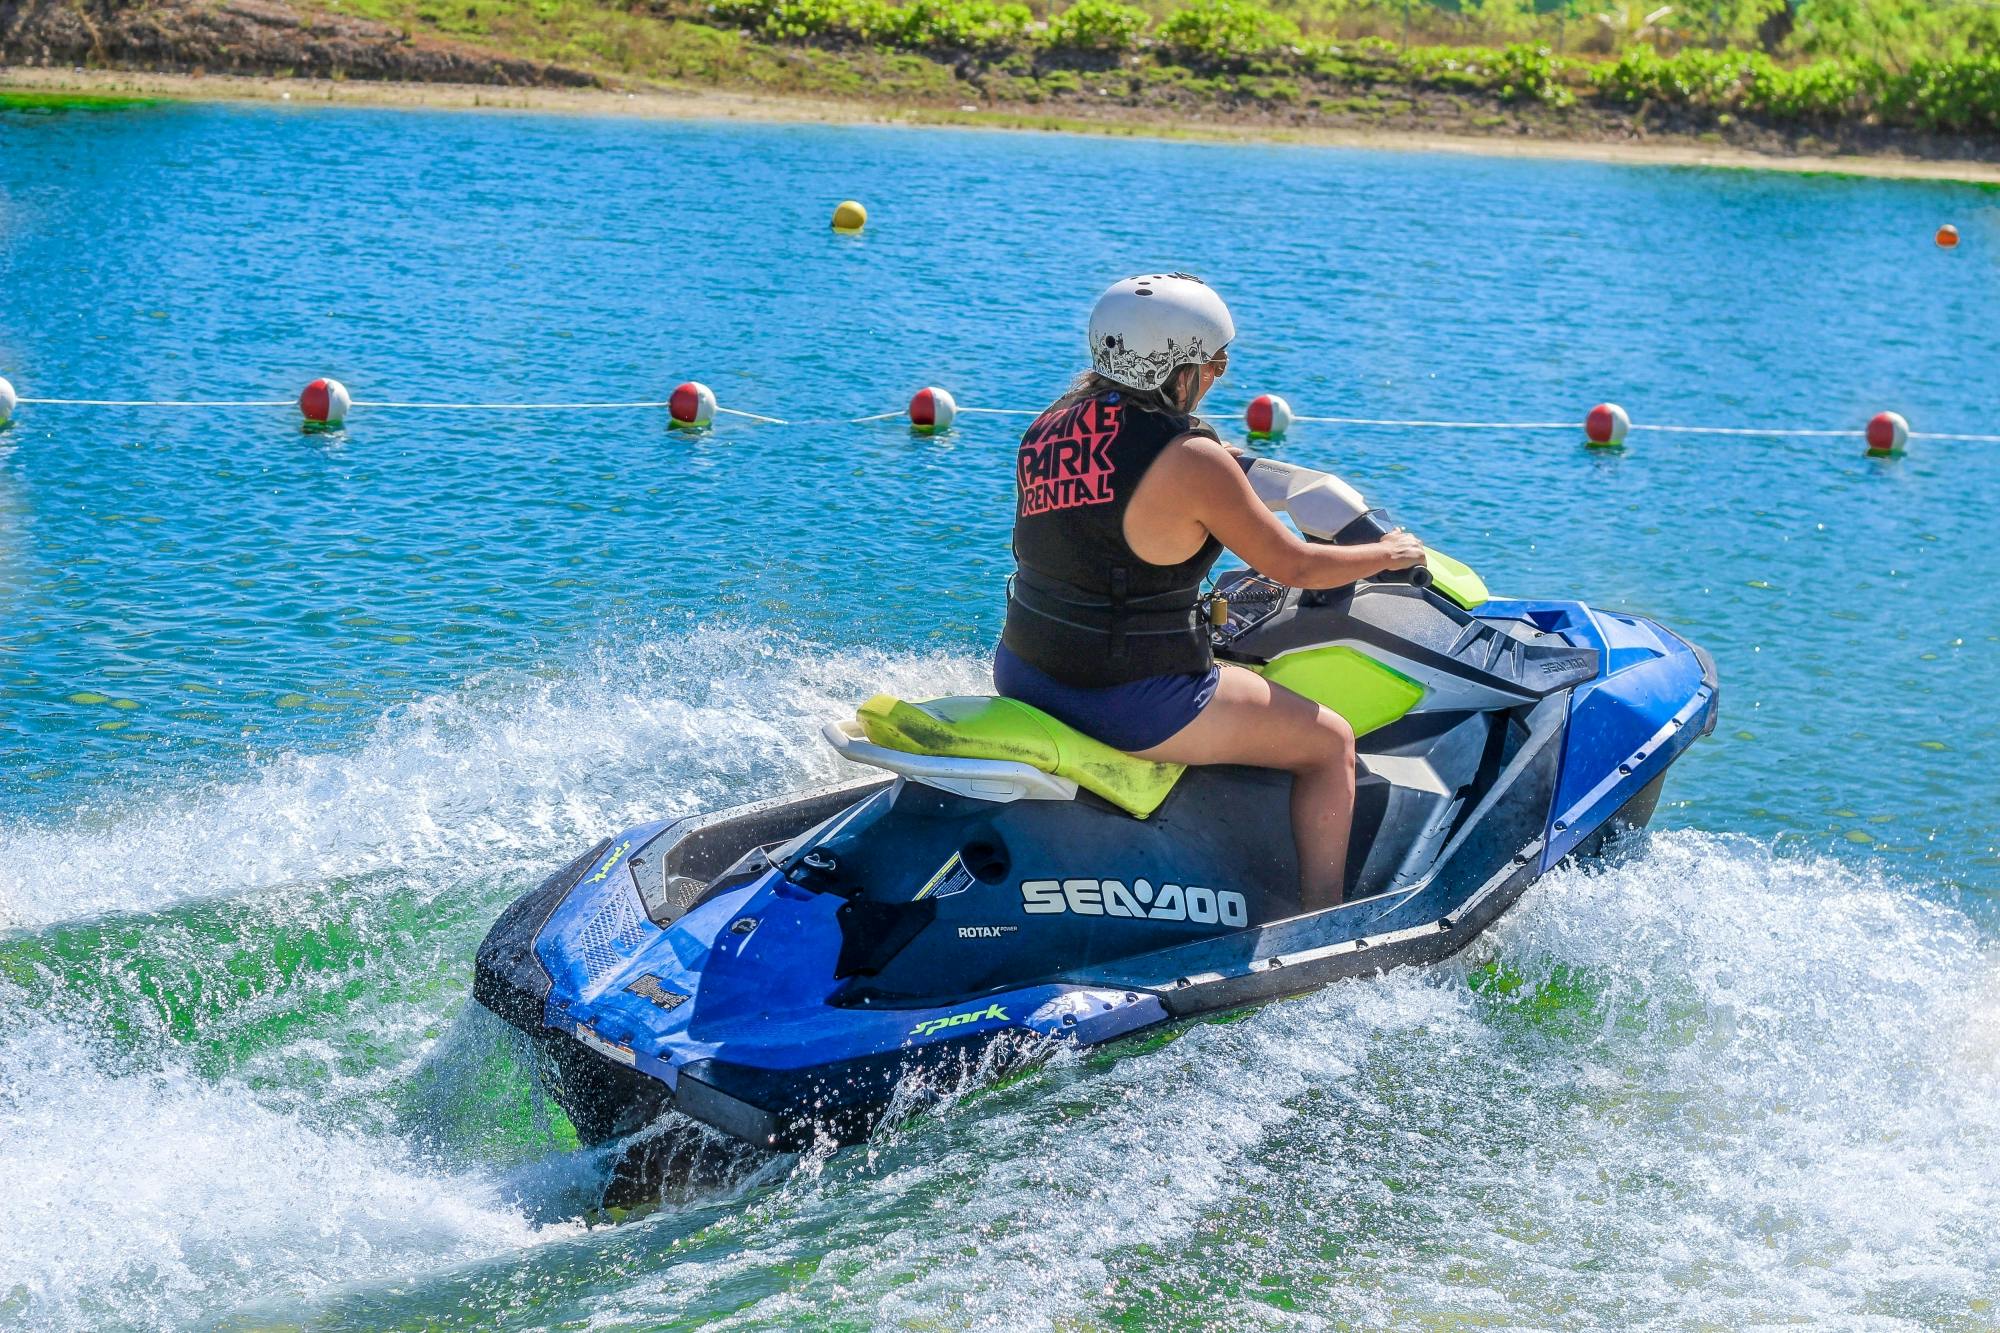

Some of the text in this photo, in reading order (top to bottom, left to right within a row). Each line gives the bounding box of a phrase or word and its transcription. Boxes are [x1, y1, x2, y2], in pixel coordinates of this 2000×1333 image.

[1018, 433, 1115, 488] PARK
[1022, 474, 1114, 517] RENTAL
[958, 926, 1001, 938] ROTAX
